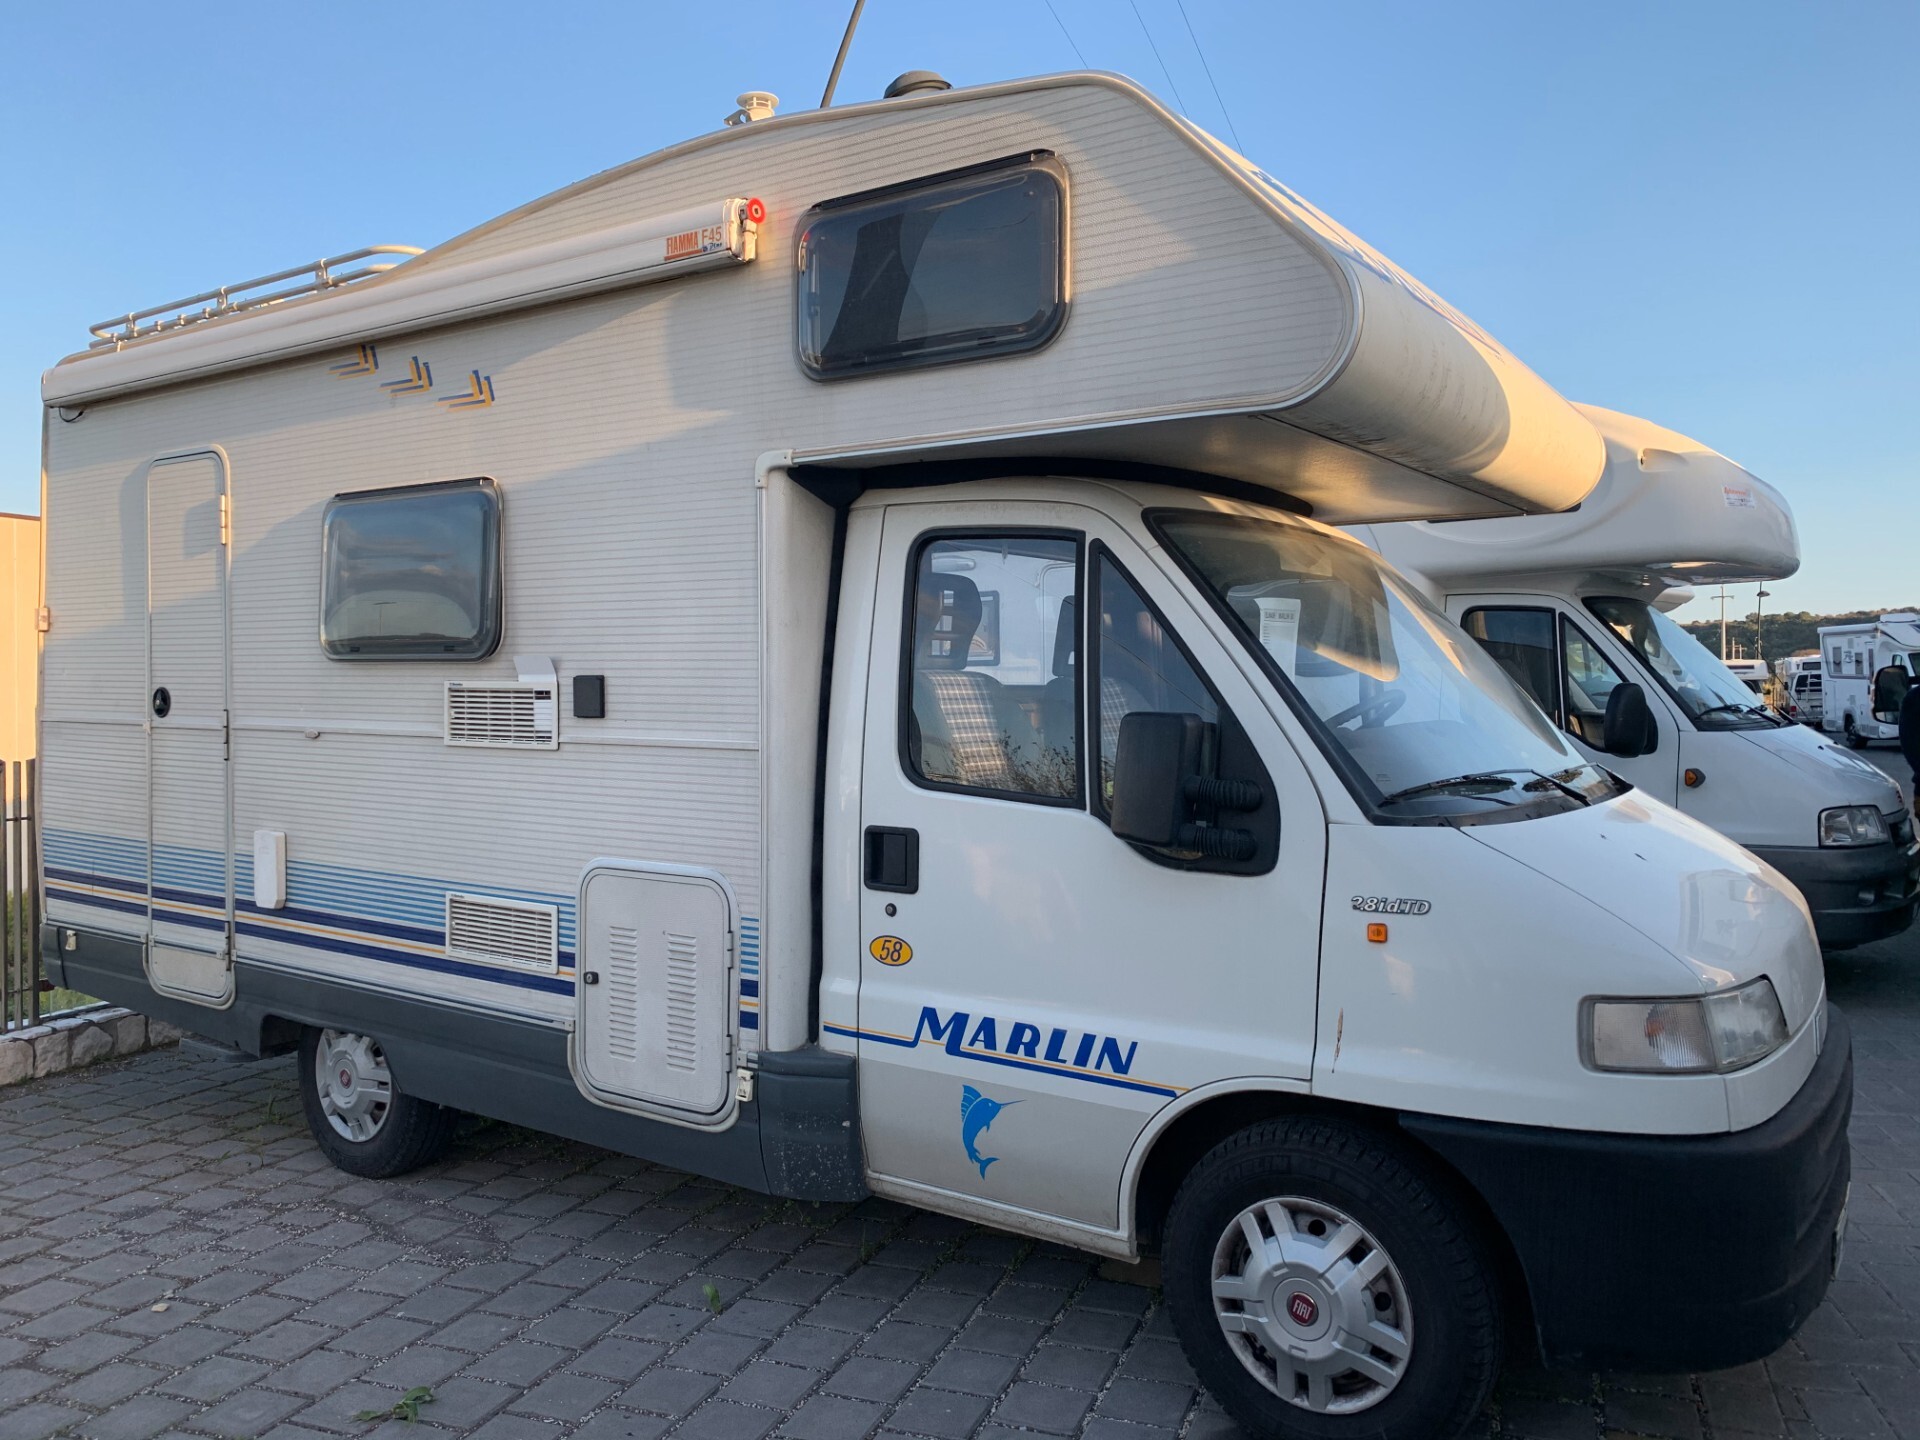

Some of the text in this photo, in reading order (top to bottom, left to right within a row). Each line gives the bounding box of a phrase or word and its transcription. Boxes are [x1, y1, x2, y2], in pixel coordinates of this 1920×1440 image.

[666, 225, 722, 255] FIAMMA F45
[880, 939, 903, 962] 58
[915, 1006, 1138, 1076] MARLIN
[1292, 1299, 1313, 1320] FIAT
